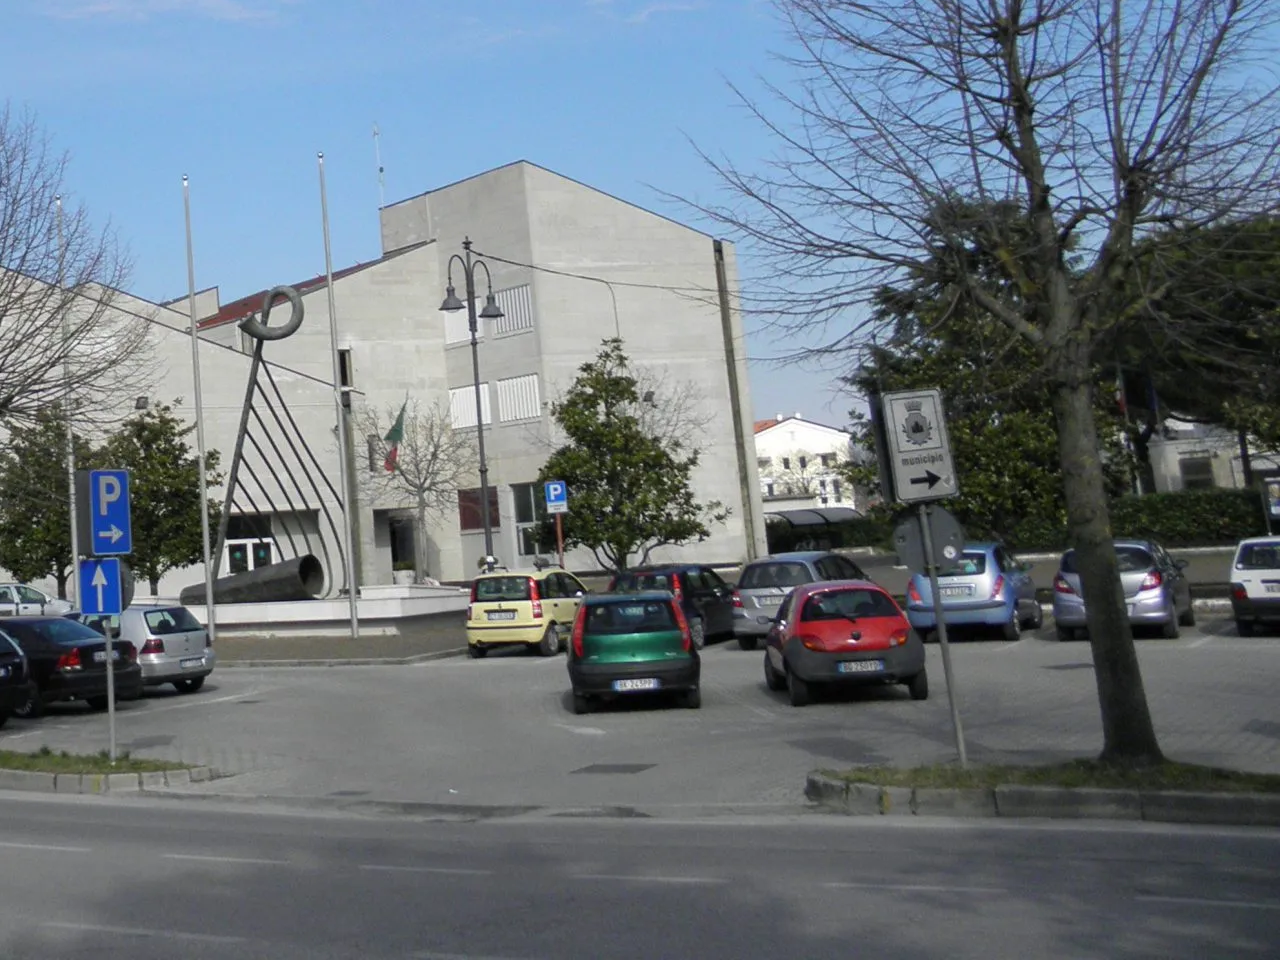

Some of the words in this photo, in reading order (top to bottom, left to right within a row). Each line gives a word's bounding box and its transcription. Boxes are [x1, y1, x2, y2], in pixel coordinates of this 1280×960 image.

[901, 453, 944, 466] municipio
[100, 476, 120, 515] P
[549, 484, 561, 500] P
